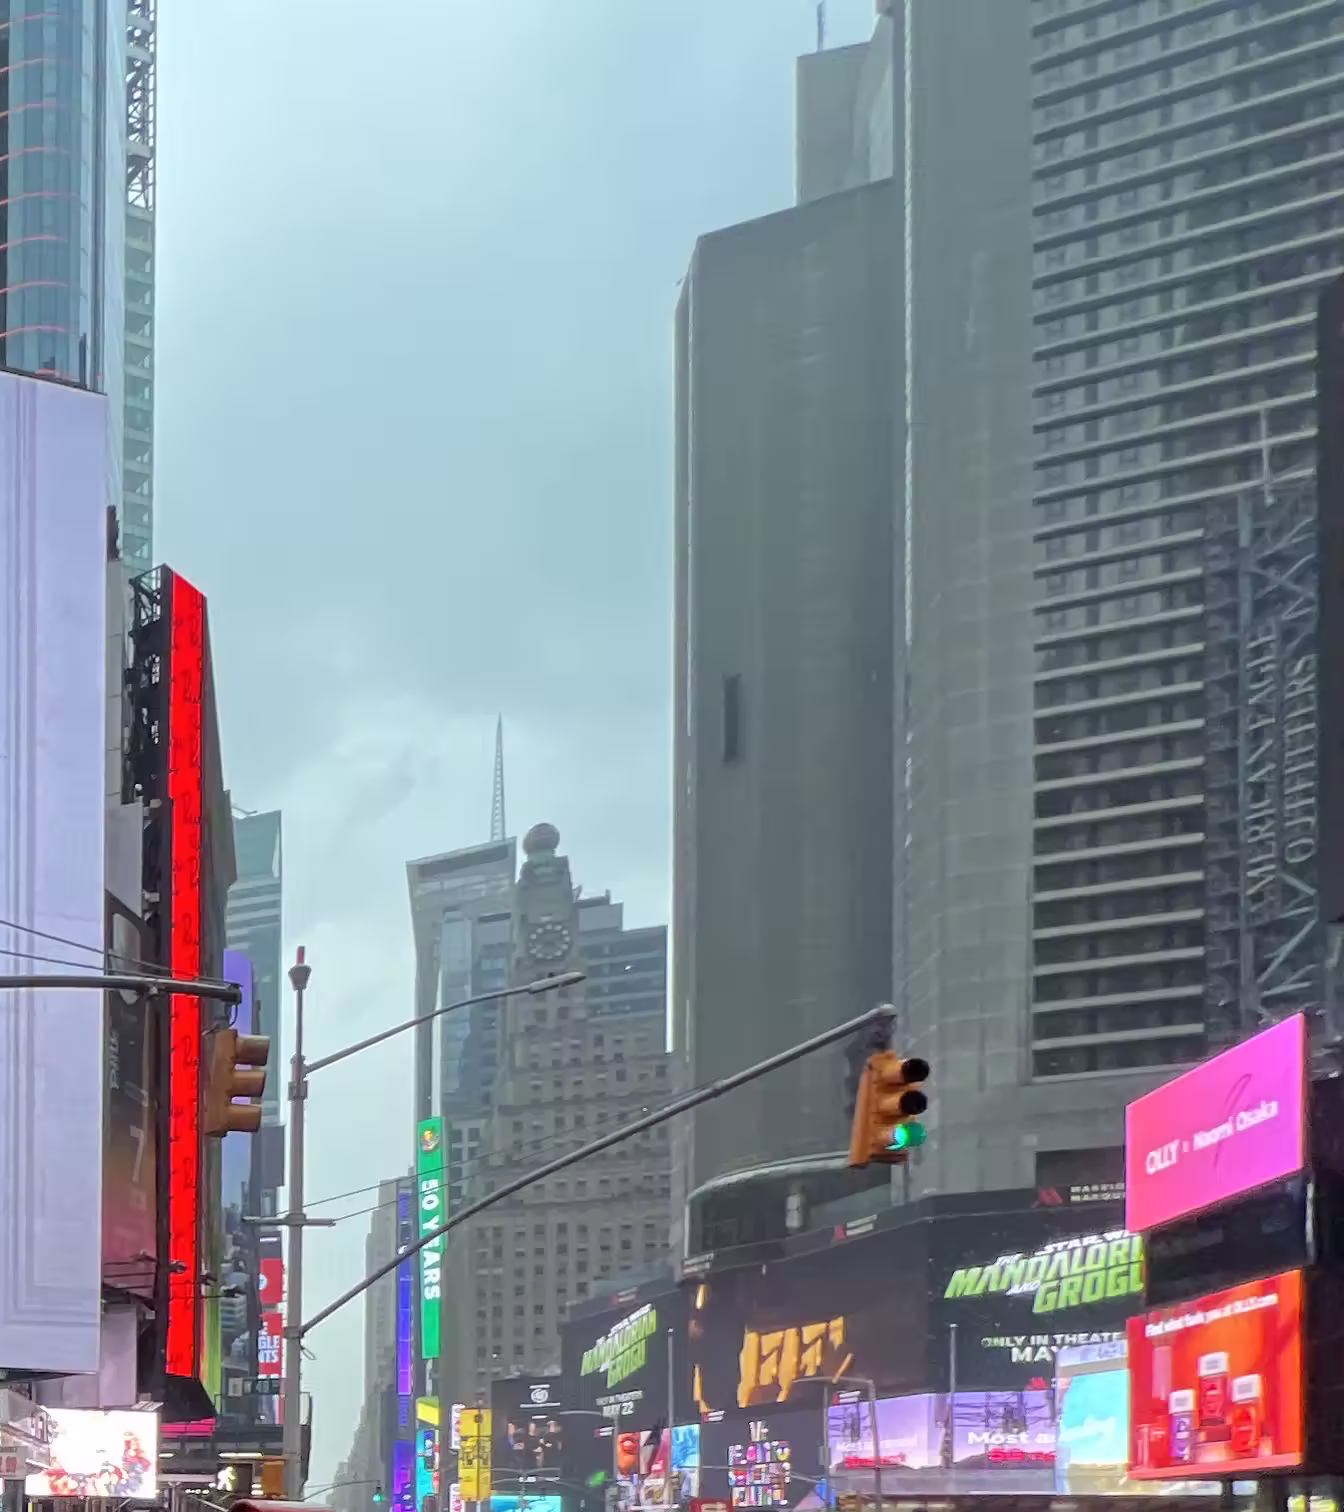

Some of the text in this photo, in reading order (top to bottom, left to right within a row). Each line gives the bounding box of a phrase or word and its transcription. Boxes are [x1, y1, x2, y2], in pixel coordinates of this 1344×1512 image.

[1146, 1139, 1179, 1175] OLLY
[1006, 1280, 1040, 1296] AND
[980, 1335, 1026, 1348] ONLY
[1030, 1334, 1049, 1345] IN
[621, 1401, 634, 1415] 22
